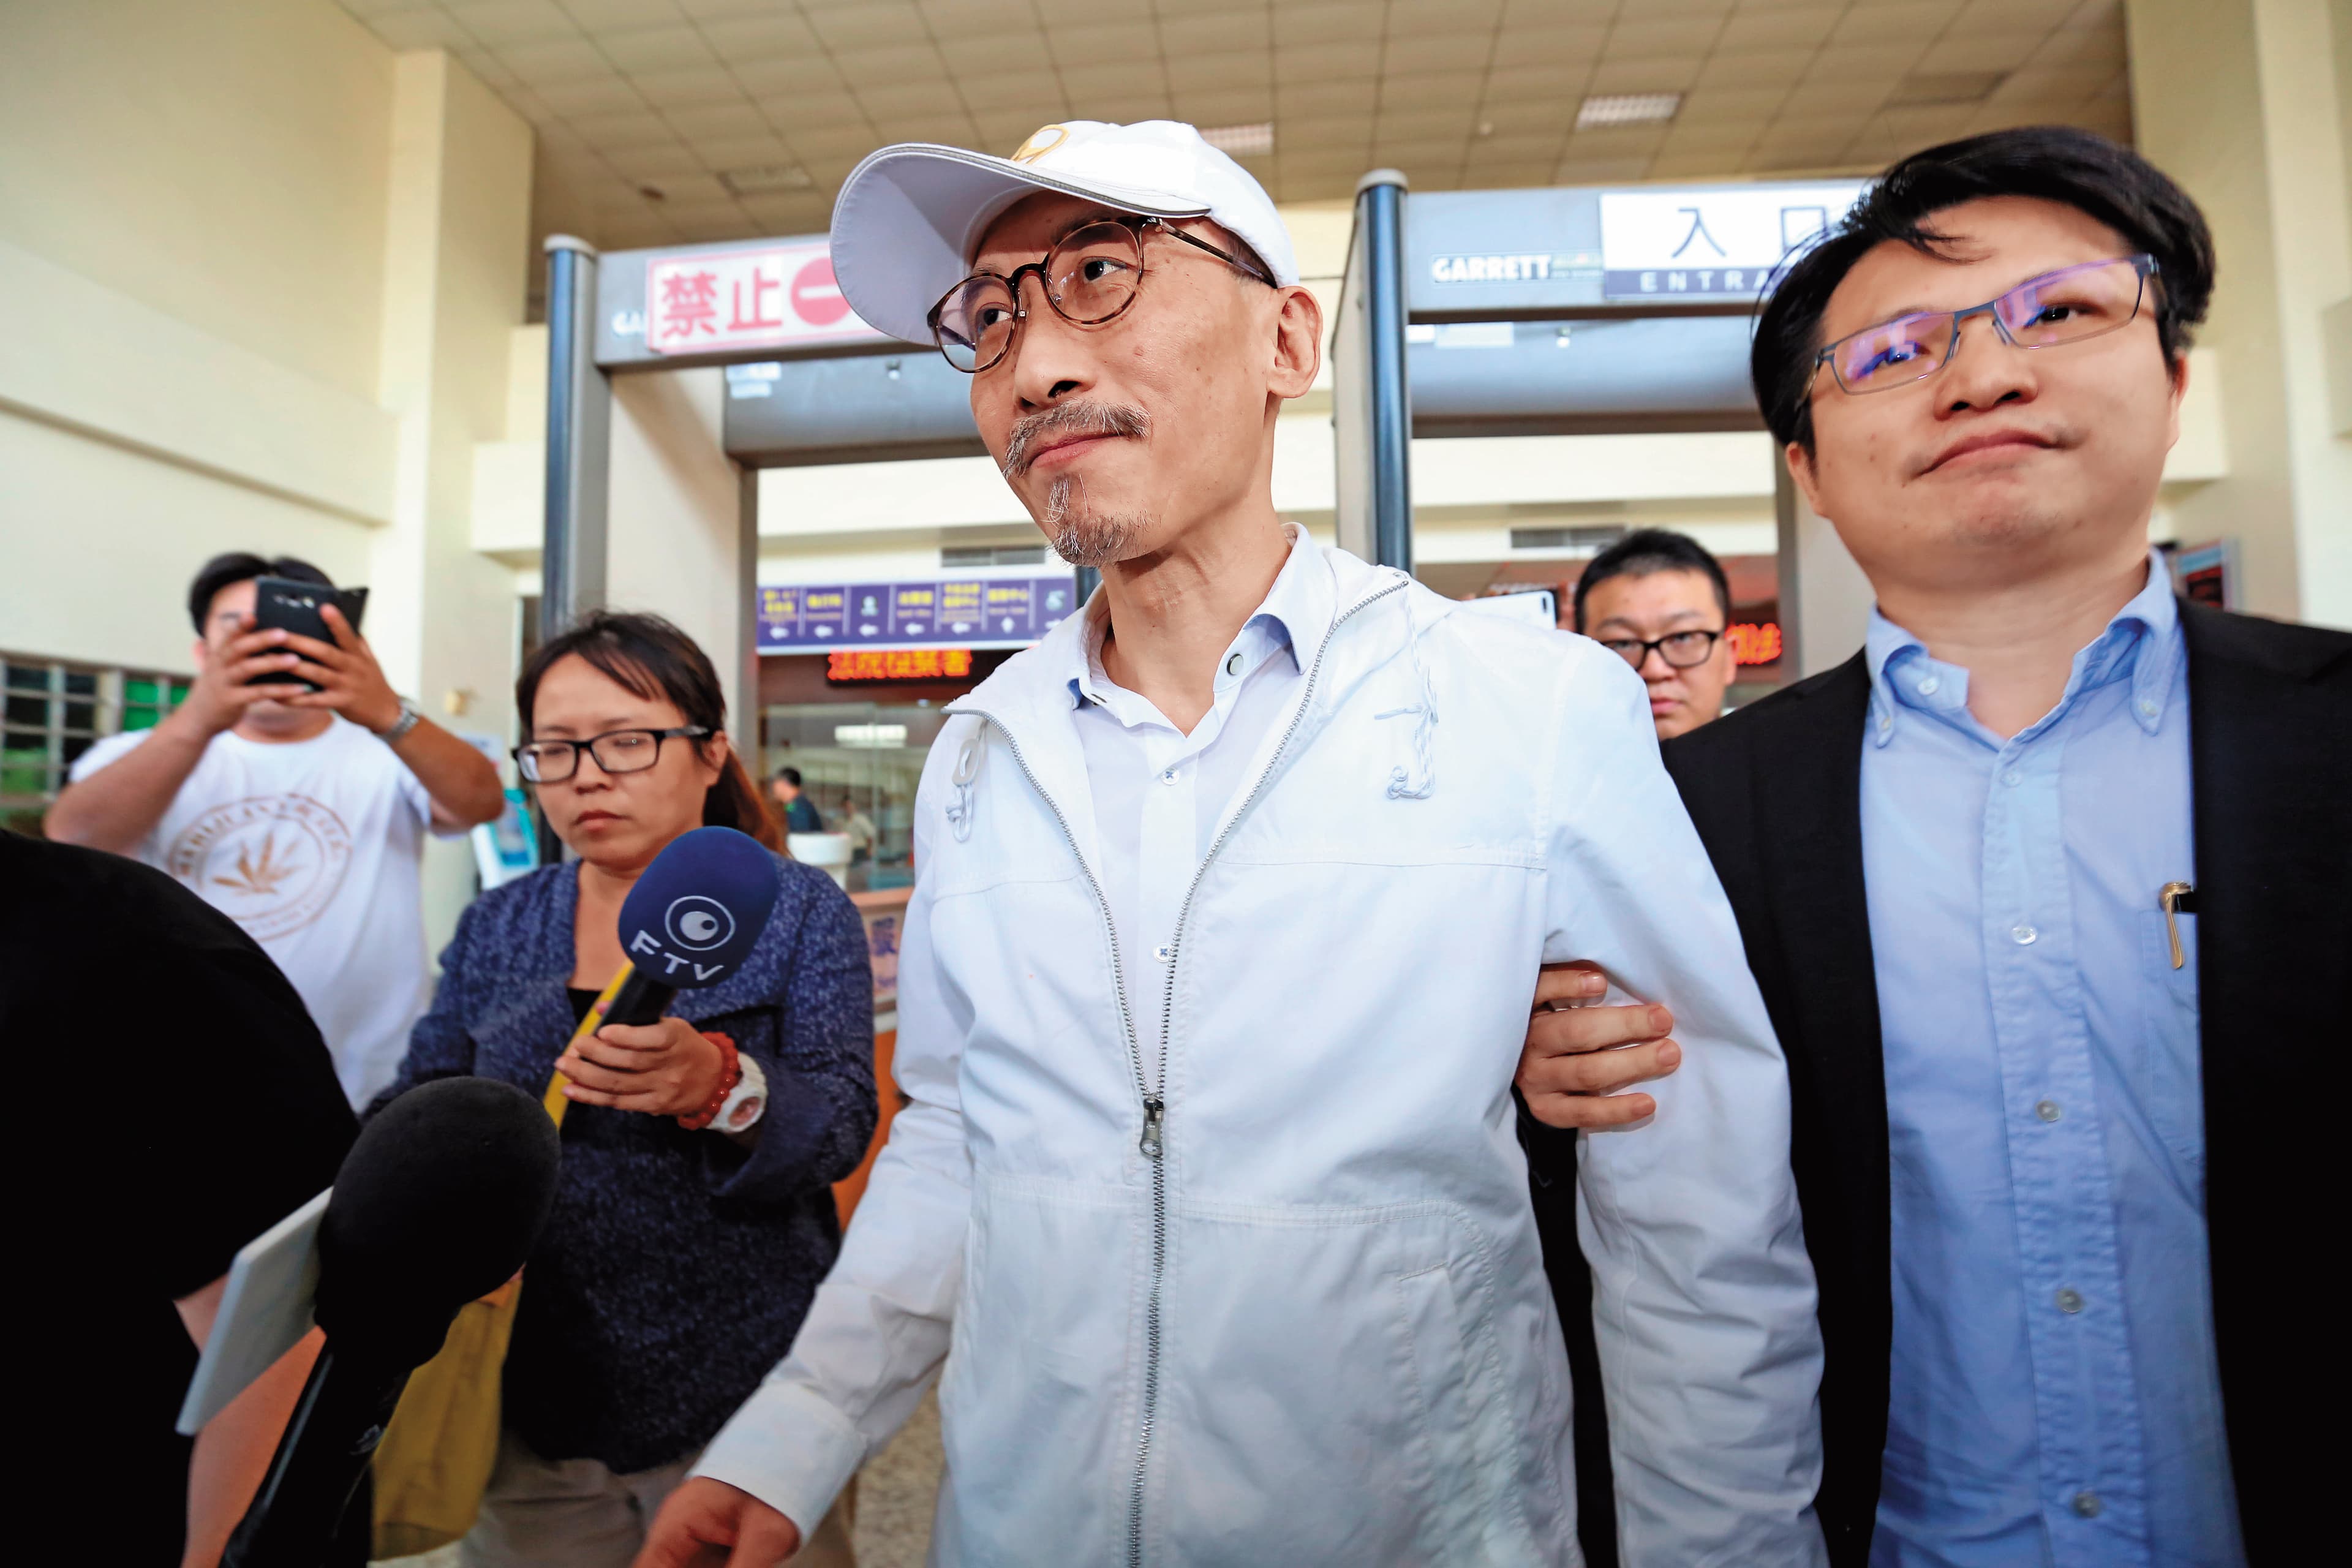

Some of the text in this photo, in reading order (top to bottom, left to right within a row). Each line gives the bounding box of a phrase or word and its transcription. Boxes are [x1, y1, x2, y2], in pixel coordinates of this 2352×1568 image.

[1671, 206, 1830, 258] 入口
[1432, 254, 1552, 282] GARRETT
[1639, 269, 1784, 293] ENTRA
[662, 268, 783, 339] 禁止
[630, 930, 725, 981] FTV
